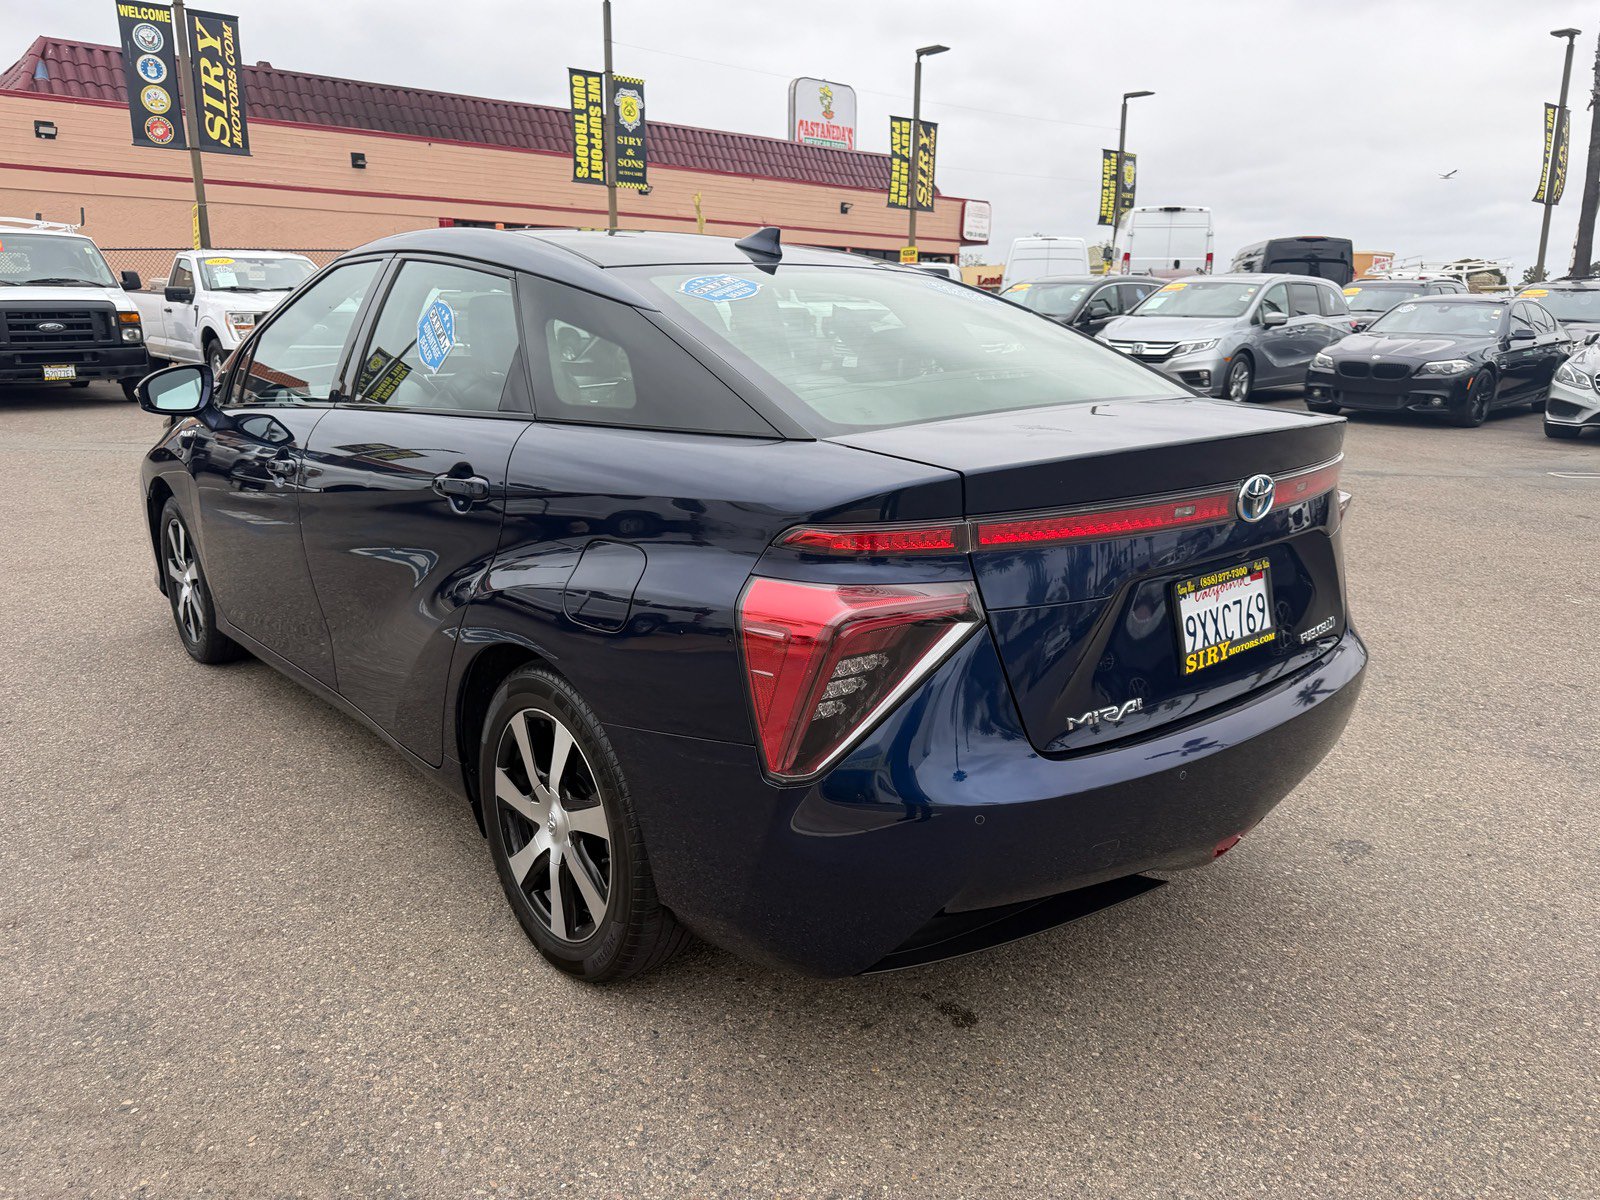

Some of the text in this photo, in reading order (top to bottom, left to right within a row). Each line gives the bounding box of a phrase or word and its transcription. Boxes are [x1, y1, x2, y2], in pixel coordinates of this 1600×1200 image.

[118, 4, 171, 23] WELCOME
[194, 16, 232, 148] SIRY
[222, 21, 243, 148] MOTORS.COM
[572, 75, 589, 179] OUR TROOPS
[587, 76, 603, 182] WE SUPPORT
[617, 135, 643, 147] SIRY
[797, 119, 853, 150] CASTAÑEDA'S
[617, 158, 644, 169] SONS
[626, 148, 635, 156] &
[889, 121, 901, 204] PAY HERE
[899, 121, 910, 206] BUY HERE
[916, 124, 932, 208] SIRY
[1101, 189, 1109, 216] CARE
[1106, 181, 1116, 224] SERVICE
[977, 274, 1002, 286] Lend
[1194, 576, 1250, 602] California
[1200, 573, 1218, 589] (858)
[1218, 566, 1248, 583] 277-7300
[1185, 592, 1266, 652] 9XXC769
[1185, 632, 1276, 674] SIRY MOTORS.COM
[1066, 697, 1143, 731] MIRAI
